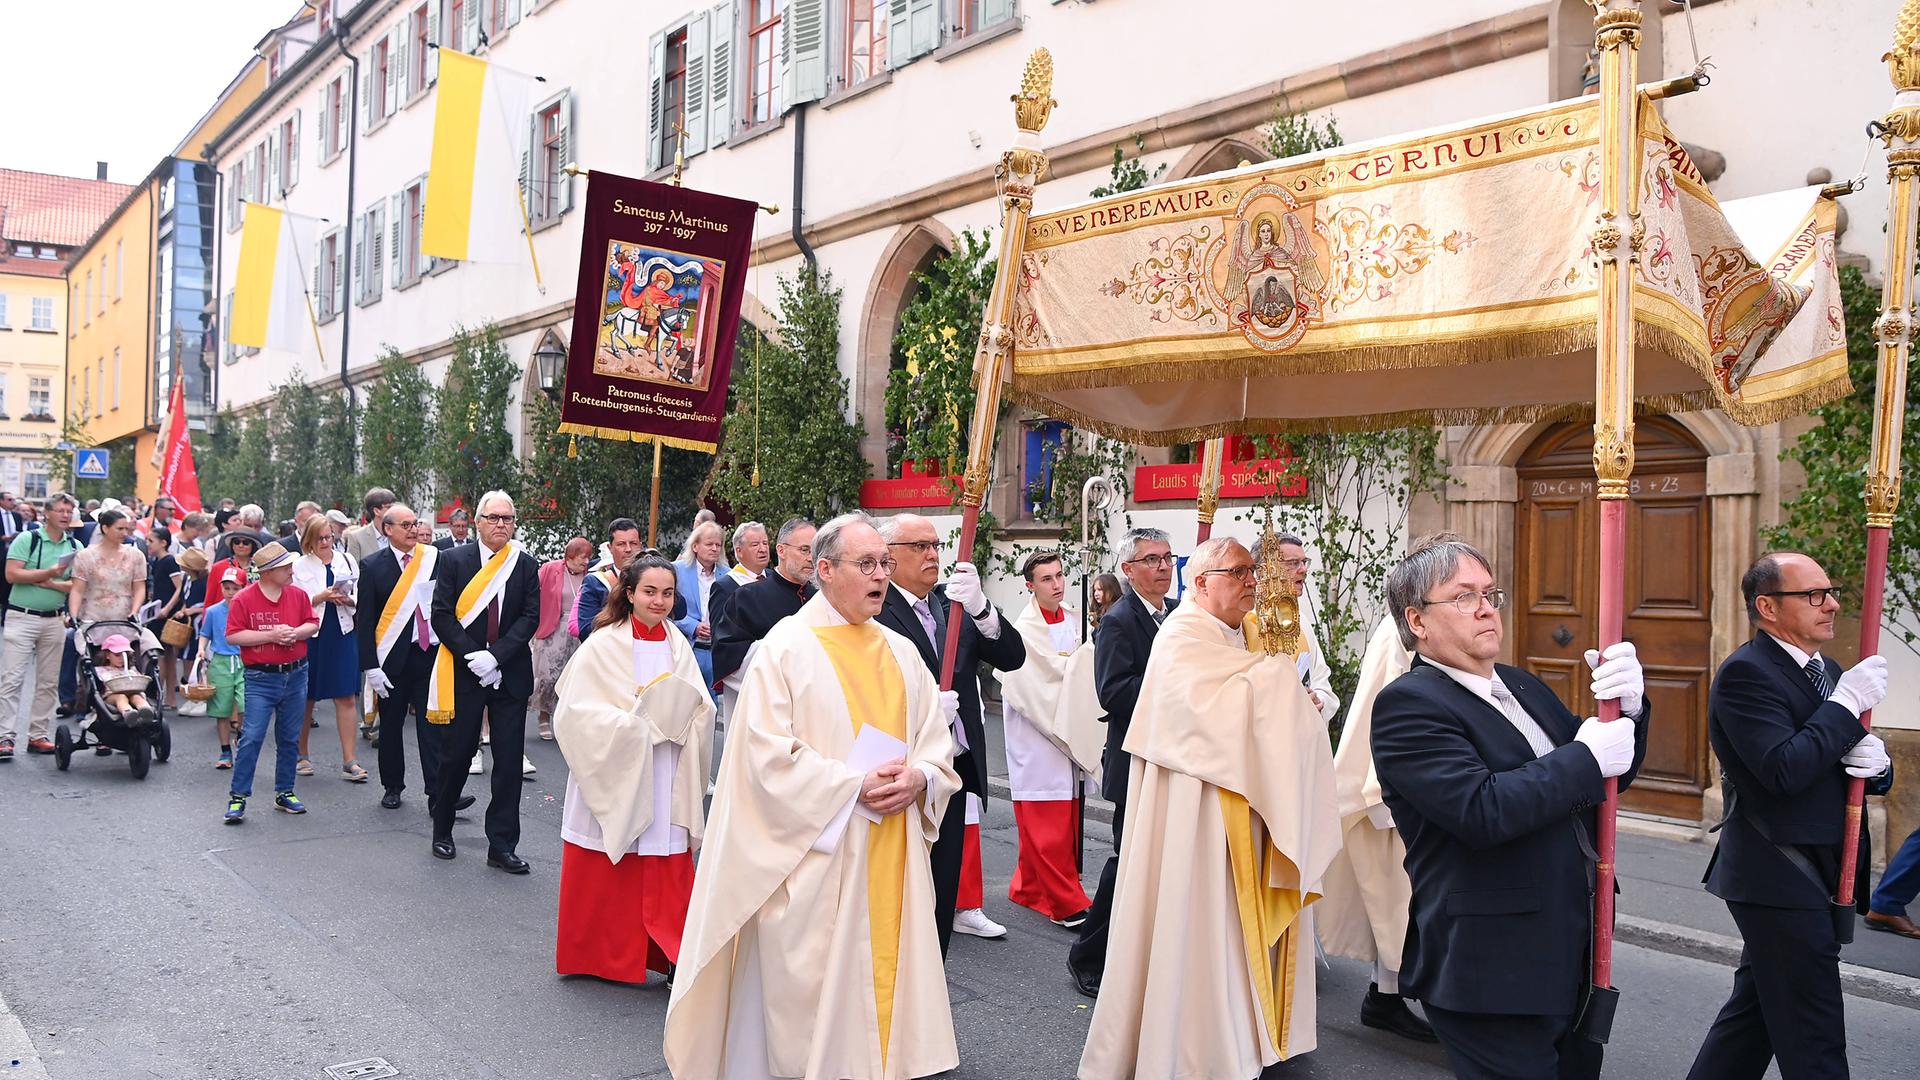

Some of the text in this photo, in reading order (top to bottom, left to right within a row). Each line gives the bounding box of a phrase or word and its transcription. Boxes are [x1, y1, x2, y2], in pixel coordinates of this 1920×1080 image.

[1055, 131, 1502, 235] VENEREMUR CERNUI
[613, 199, 729, 233] Sanctus Martinus
[643, 221, 663, 234] 397
[672, 226, 697, 240] 1997
[572, 392, 717, 423] Rottenburgensis-Stutgardiensis
[607, 385, 693, 408] Patronus dioecesis
[1152, 473, 1187, 489] Laudis
[1192, 472, 1225, 488] tha
